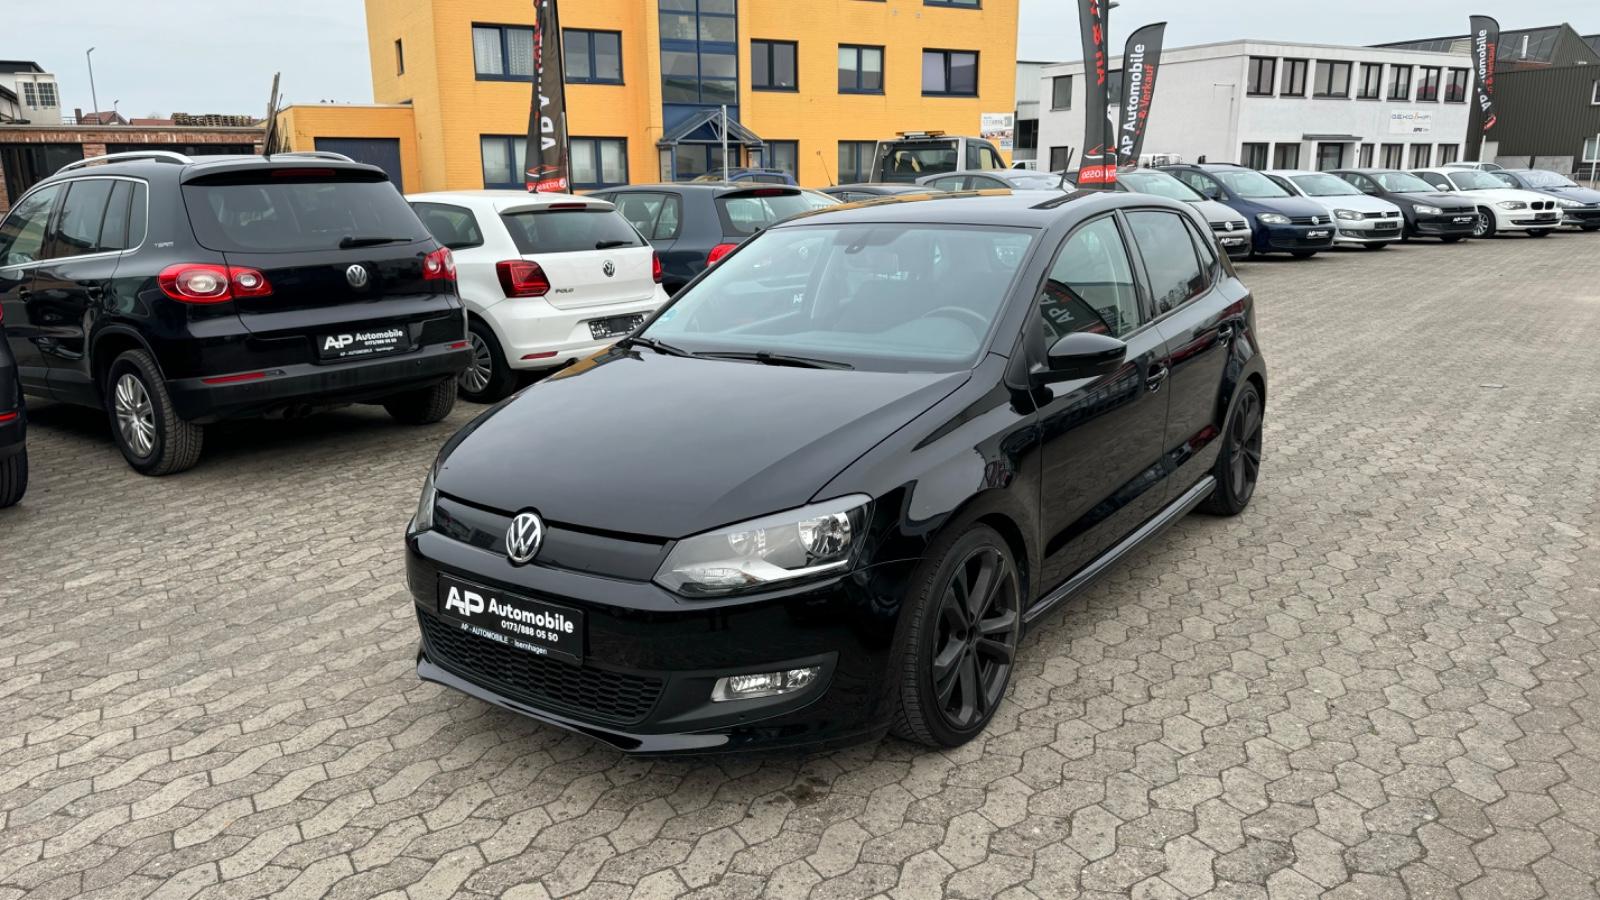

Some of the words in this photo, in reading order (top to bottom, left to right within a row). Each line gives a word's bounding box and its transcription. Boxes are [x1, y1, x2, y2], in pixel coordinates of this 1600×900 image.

[1123, 44, 1145, 132] Automobile
[1139, 64, 1154, 108] Verkauf
[1121, 135, 1133, 156] AP
[324, 334, 353, 350] AP
[355, 328, 403, 341] Automobile
[445, 586, 484, 616] AP
[488, 598, 574, 634] Automobile
[460, 622, 468, 630] AP
[471, 626, 509, 644] AUTOMOBILE
[501, 619, 535, 636] 0173/888
[536, 629, 547, 639] 05
[548, 633, 559, 642] 50
